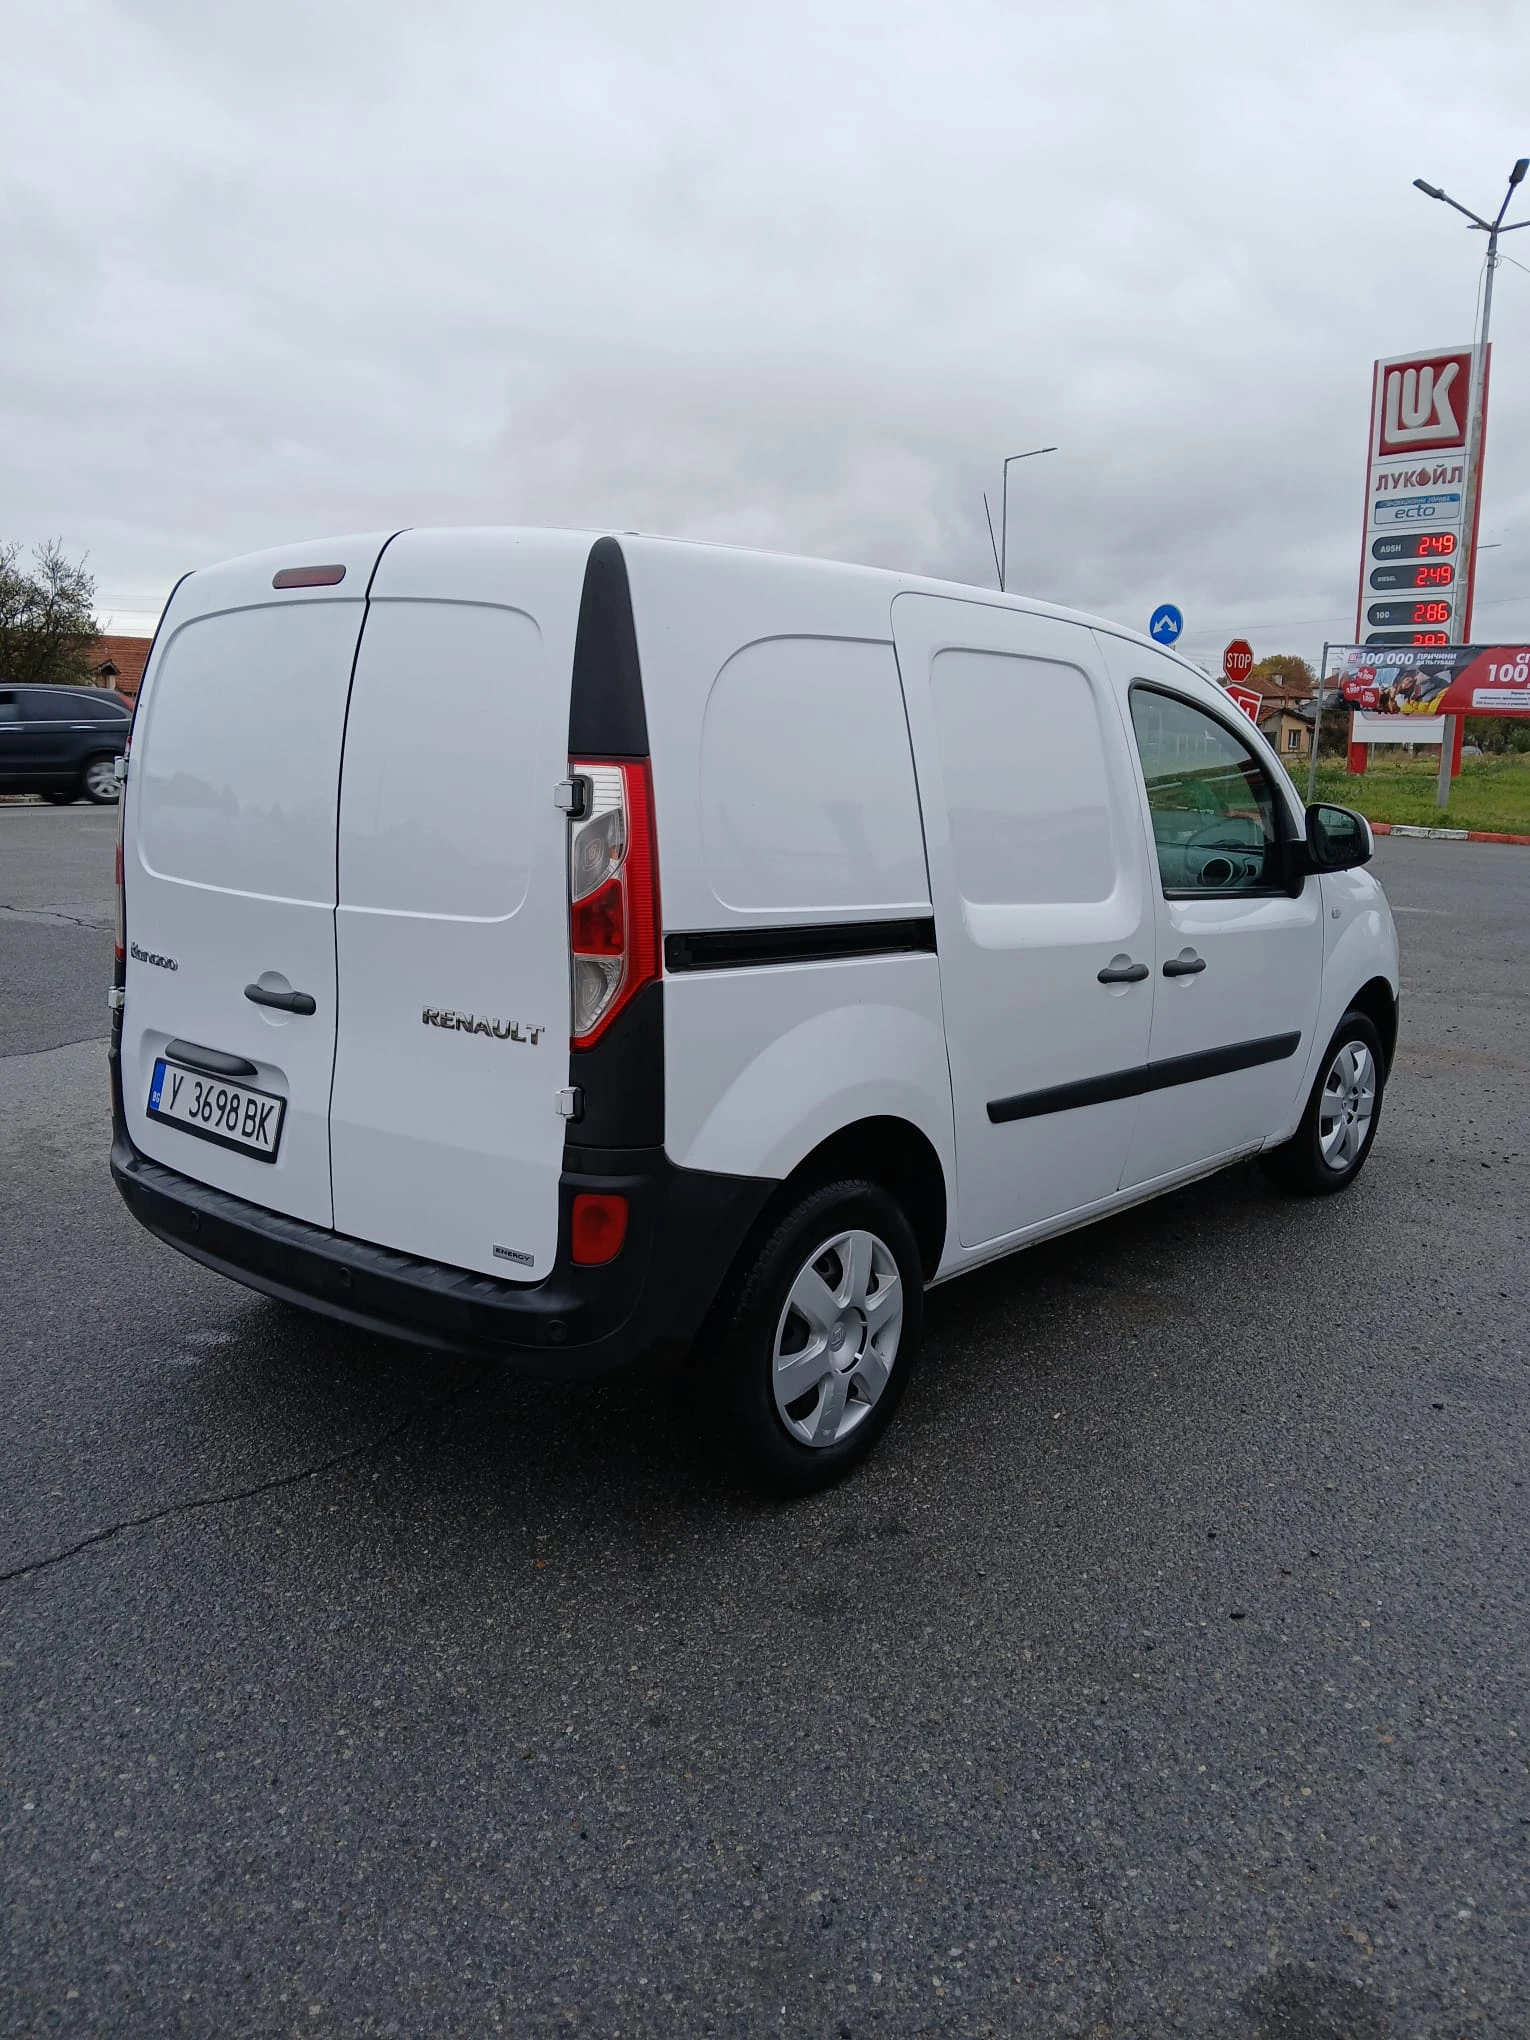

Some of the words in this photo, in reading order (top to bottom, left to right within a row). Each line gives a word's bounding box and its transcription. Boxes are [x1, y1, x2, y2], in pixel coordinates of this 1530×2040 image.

[1395, 505, 1435, 518] ecto
[1376, 611, 1390, 619] 100
[1227, 653, 1251, 669] STOP
[1361, 652, 1385, 665] 100
[1386, 653, 1414, 665] 000
[1488, 663, 1529, 683] 100
[422, 1005, 546, 1046] RENAULT
[151, 1090, 161, 1104] BG
[496, 1248, 530, 1261] ENERGY
